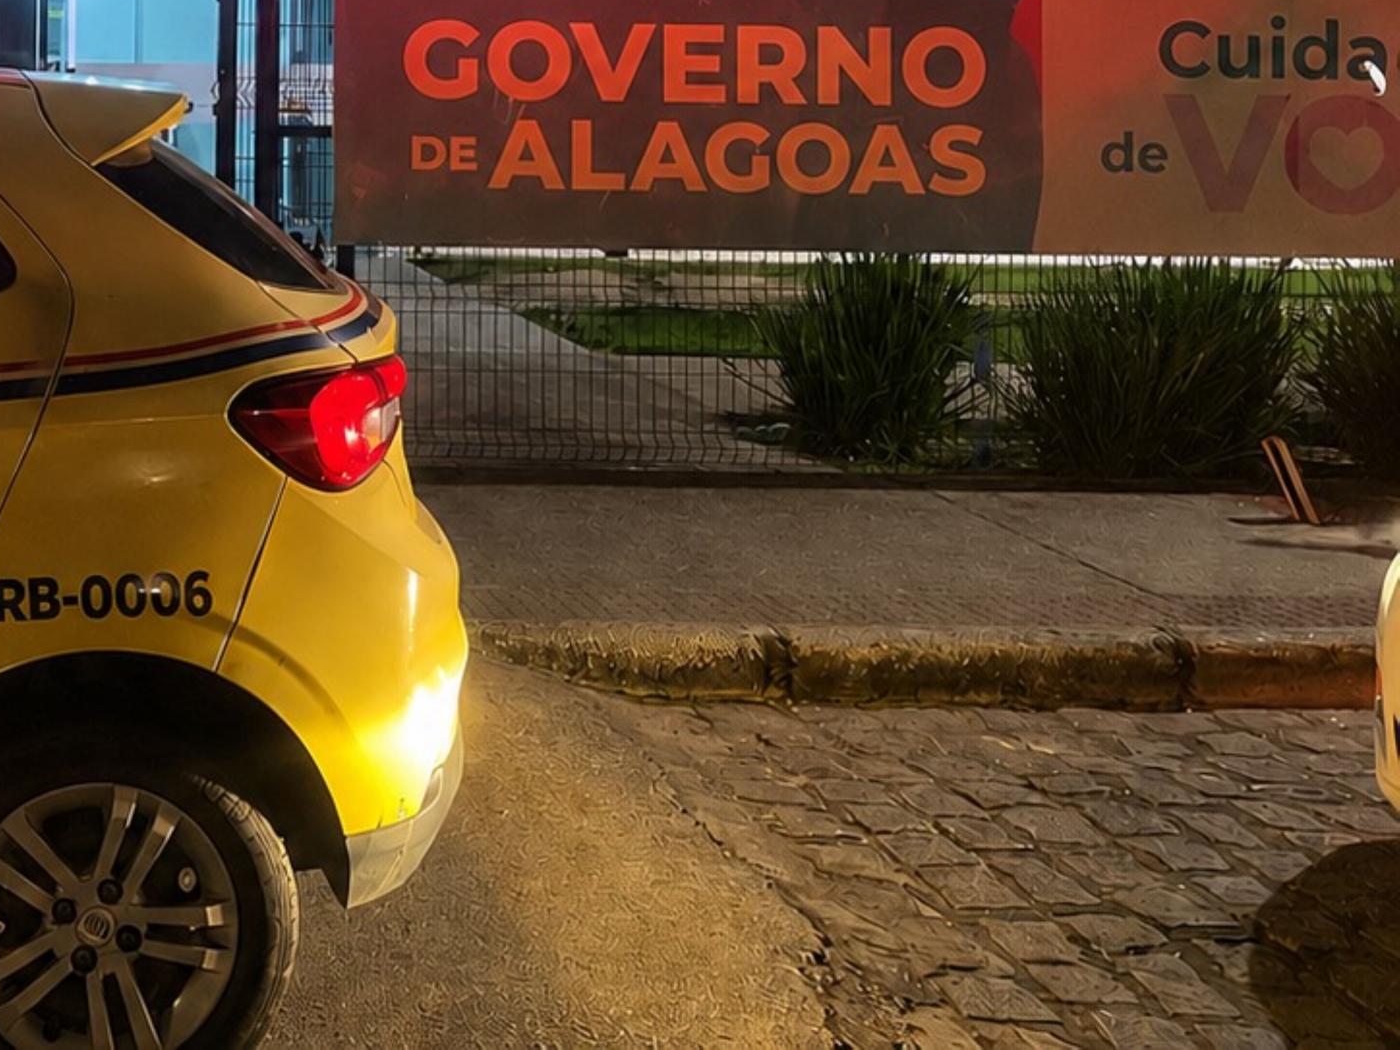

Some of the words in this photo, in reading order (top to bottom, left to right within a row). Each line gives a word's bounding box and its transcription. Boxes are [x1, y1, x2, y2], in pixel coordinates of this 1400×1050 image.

[403, 19, 987, 108] GOVERNO
[411, 136, 477, 171] DE
[488, 119, 986, 196] ALAGOAS
[1100, 131, 1168, 173] de
